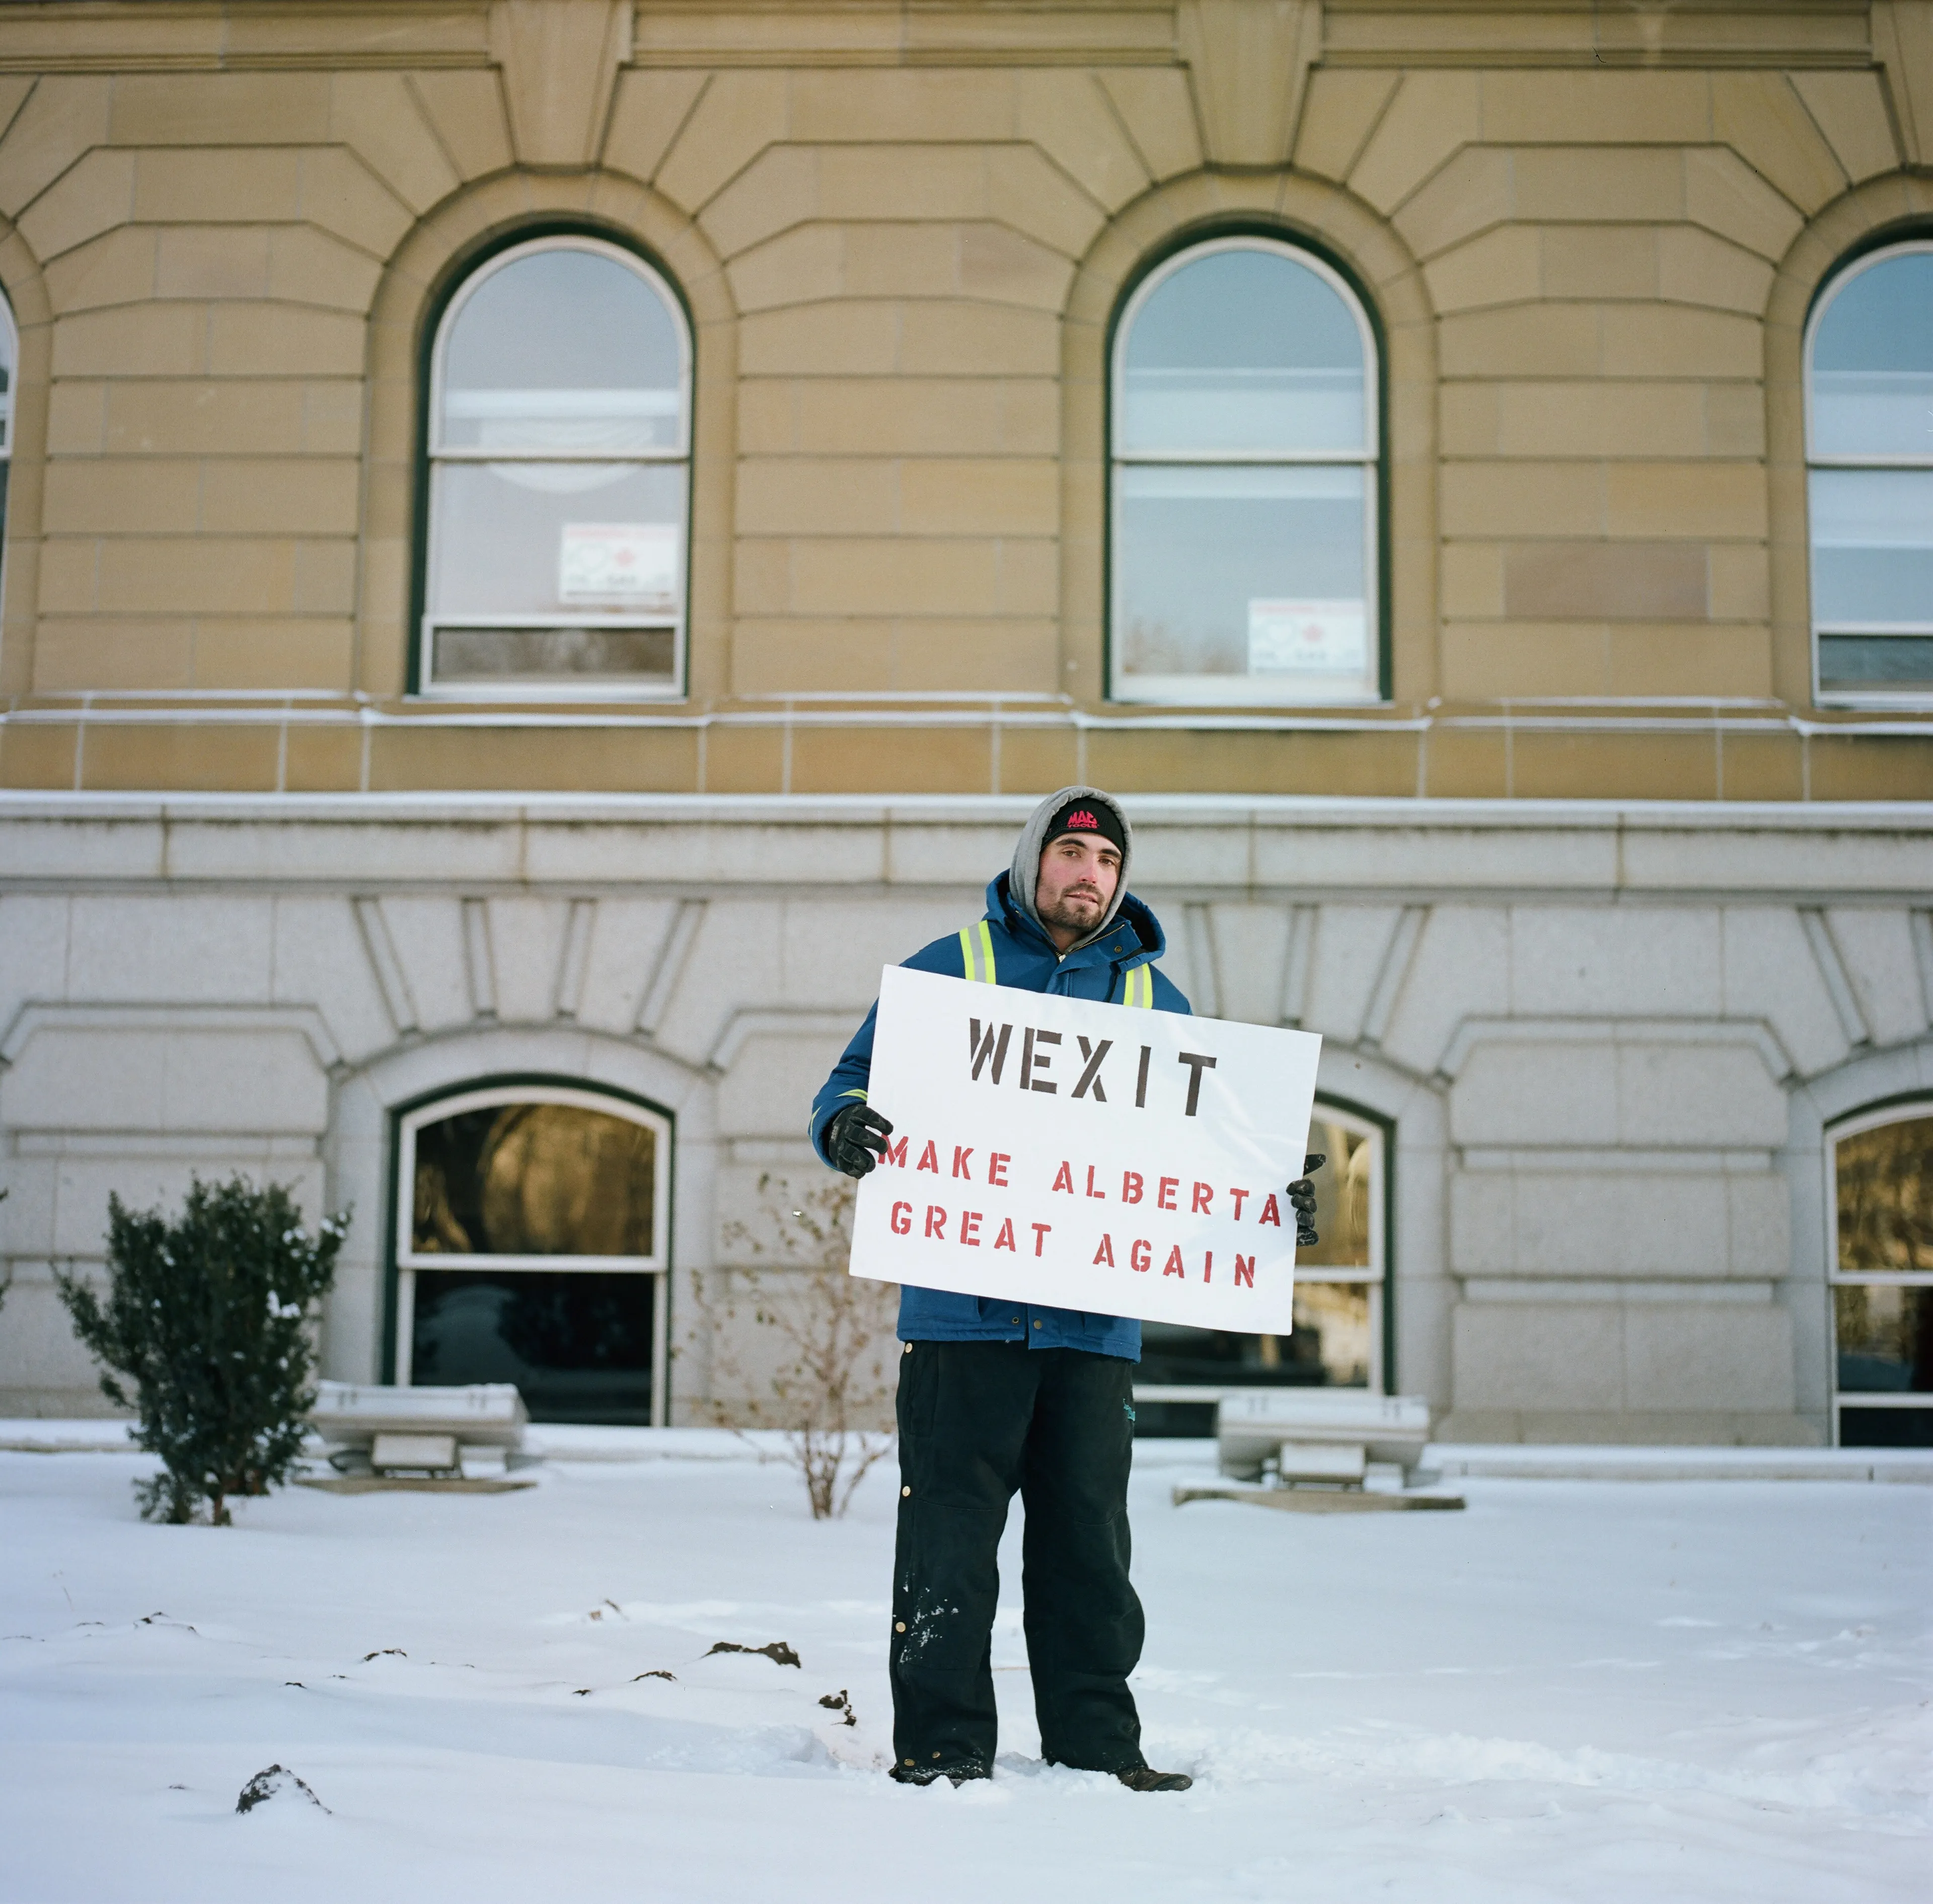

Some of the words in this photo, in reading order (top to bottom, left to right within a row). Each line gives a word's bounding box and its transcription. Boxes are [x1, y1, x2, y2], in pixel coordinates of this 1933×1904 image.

[1068, 810, 1097, 824] MAC
[970, 1017, 1217, 1117] WEXIT
[877, 1134, 1011, 1187] MAKE
[1052, 1161, 1281, 1227] ALBERTA
[890, 1201, 1052, 1257] GREAT
[1093, 1233, 1255, 1288] AGAIN
